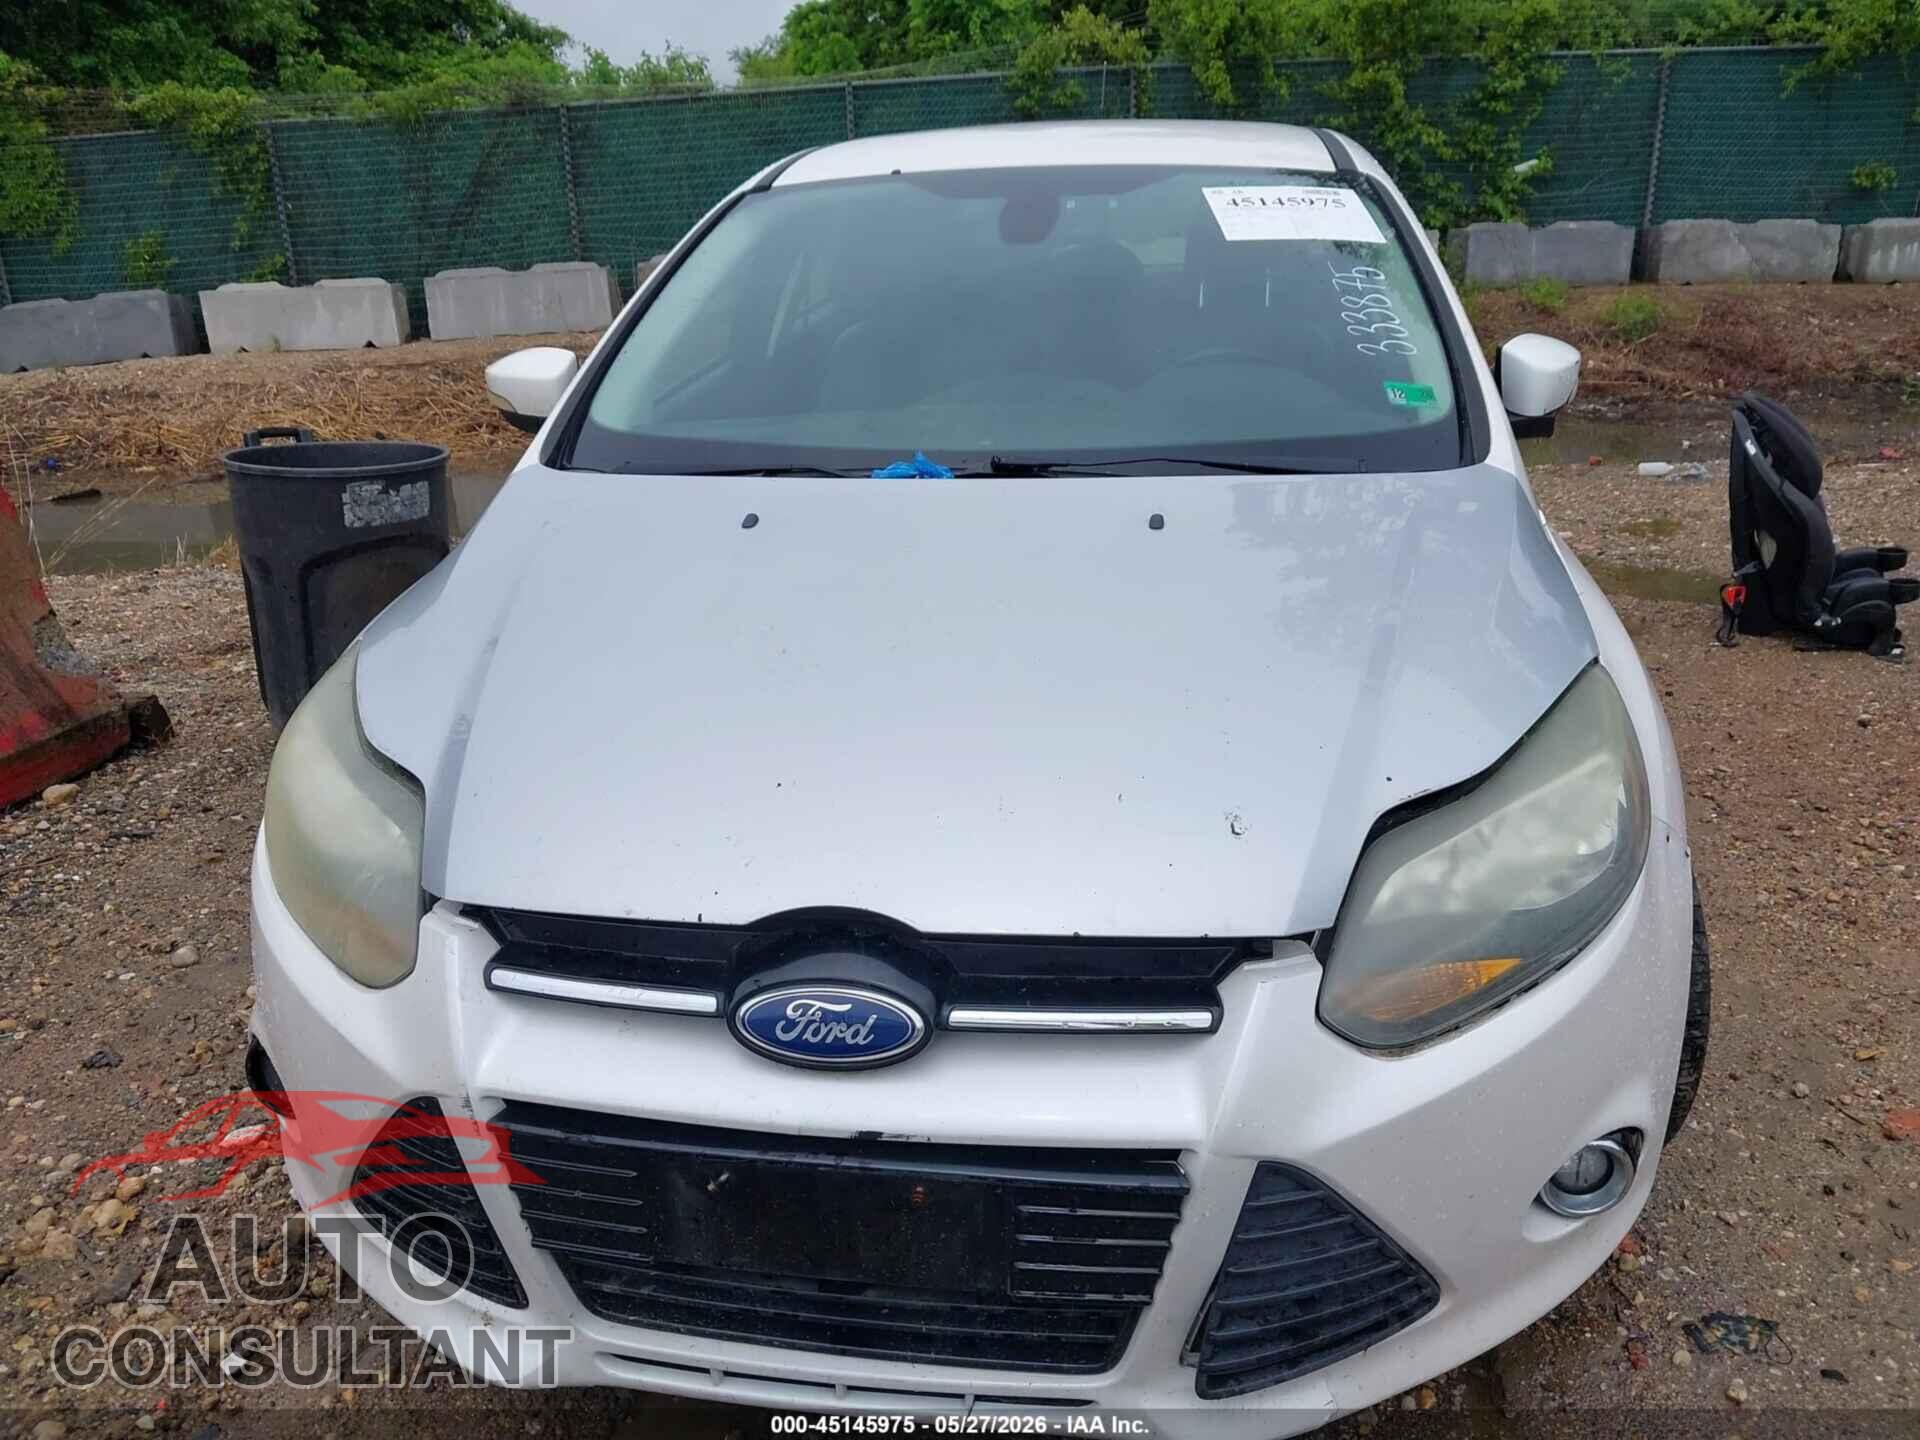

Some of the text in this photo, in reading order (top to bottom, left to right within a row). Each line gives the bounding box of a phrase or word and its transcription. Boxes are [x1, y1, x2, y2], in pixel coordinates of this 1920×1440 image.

[1226, 197, 1347, 209] 45145975
[1328, 261, 1417, 356] 333875
[775, 999, 878, 1045] Ford
